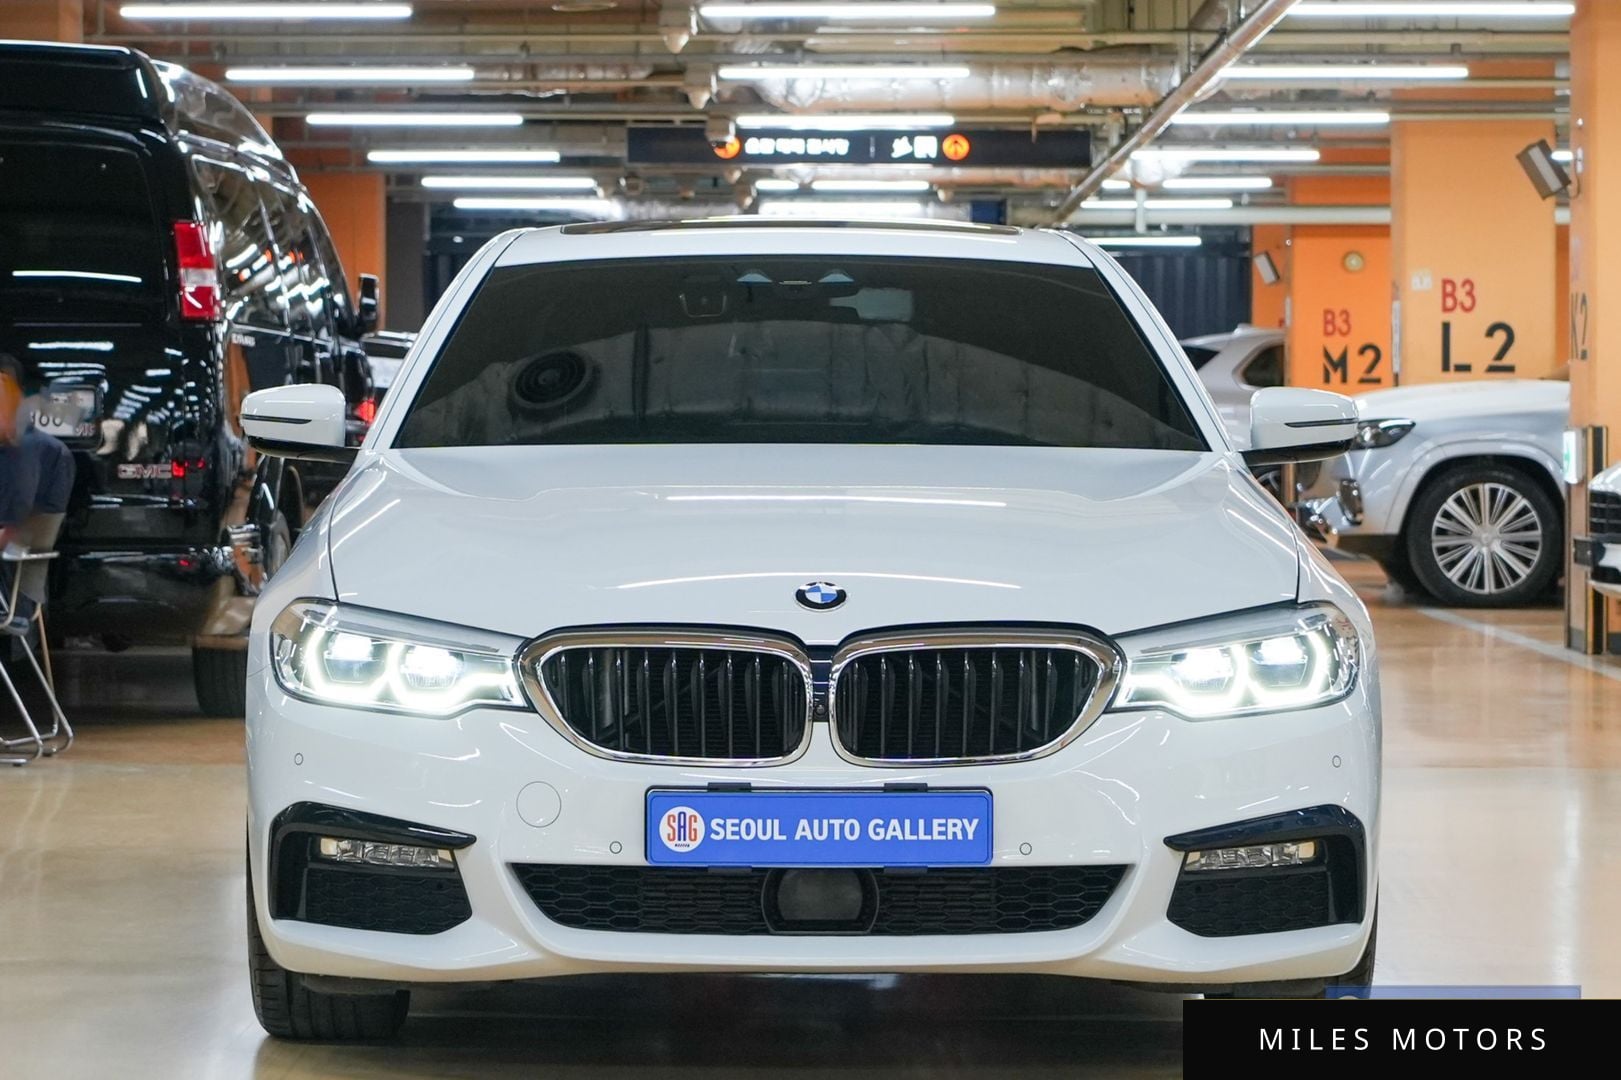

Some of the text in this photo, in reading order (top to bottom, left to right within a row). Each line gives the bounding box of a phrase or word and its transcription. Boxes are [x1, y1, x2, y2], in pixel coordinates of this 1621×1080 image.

[1441, 278, 1476, 313] B3
[1323, 309, 1351, 337] B3
[1323, 343, 1382, 384] M2
[118, 463, 172, 479] GMC
[667, 811, 698, 842] SAG
[710, 818, 979, 841] SEOUL AUTO GALLERY
